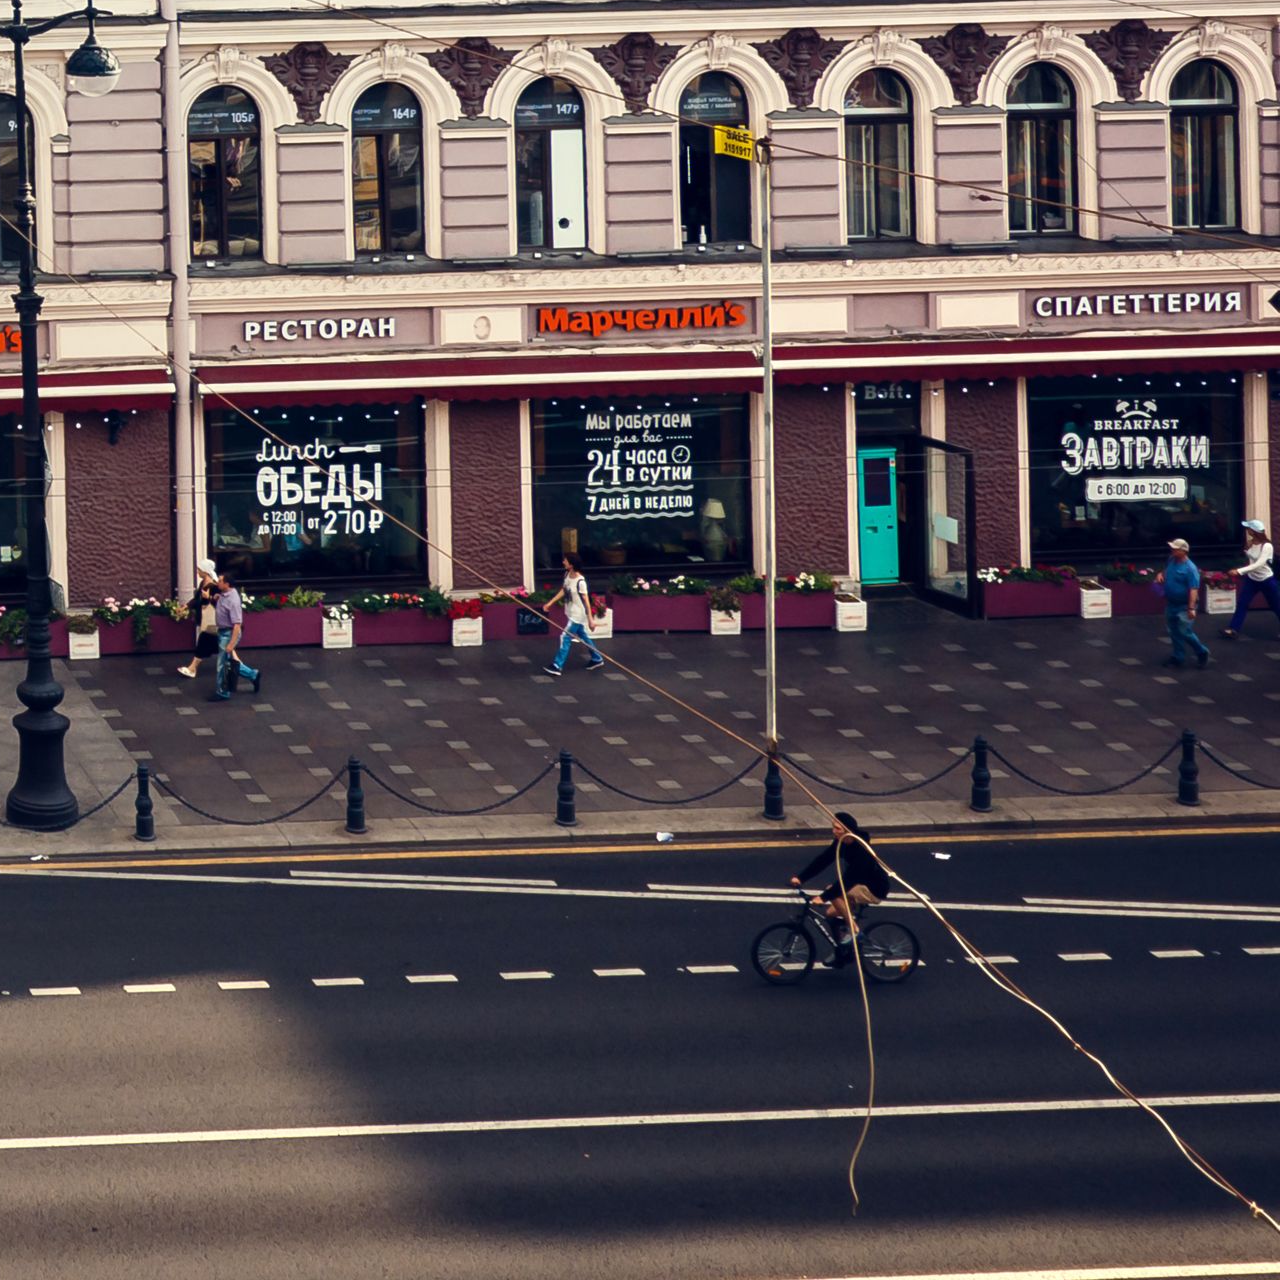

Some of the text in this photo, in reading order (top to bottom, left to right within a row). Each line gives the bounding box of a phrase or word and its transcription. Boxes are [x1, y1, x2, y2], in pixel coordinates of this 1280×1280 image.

[1035, 291, 1241, 317] СПАГЕТТЕРИЯ
[538, 300, 747, 337] Марчелли's
[244, 317, 396, 342] РЕСТОРАН
[585, 413, 692, 432] Мы работаем
[1093, 419, 1180, 431] BREAKFAST
[613, 429, 664, 449] для вас
[255, 437, 336, 462] Lunch
[625, 448, 667, 465] часа
[1060, 432, 1210, 476] ЗАВТРАКИ
[587, 449, 622, 486] 24
[256, 462, 382, 510] ОБЕДЫ
[1105, 483, 1130, 496] 6:00
[1148, 482, 1177, 495] 12:00
[587, 495, 597, 513] 7
[599, 494, 630, 513] ДНЕЙ
[644, 494, 693, 510] НЕДЕЛЮ
[271, 511, 297, 522] 12:00
[271, 523, 297, 535] 17:00
